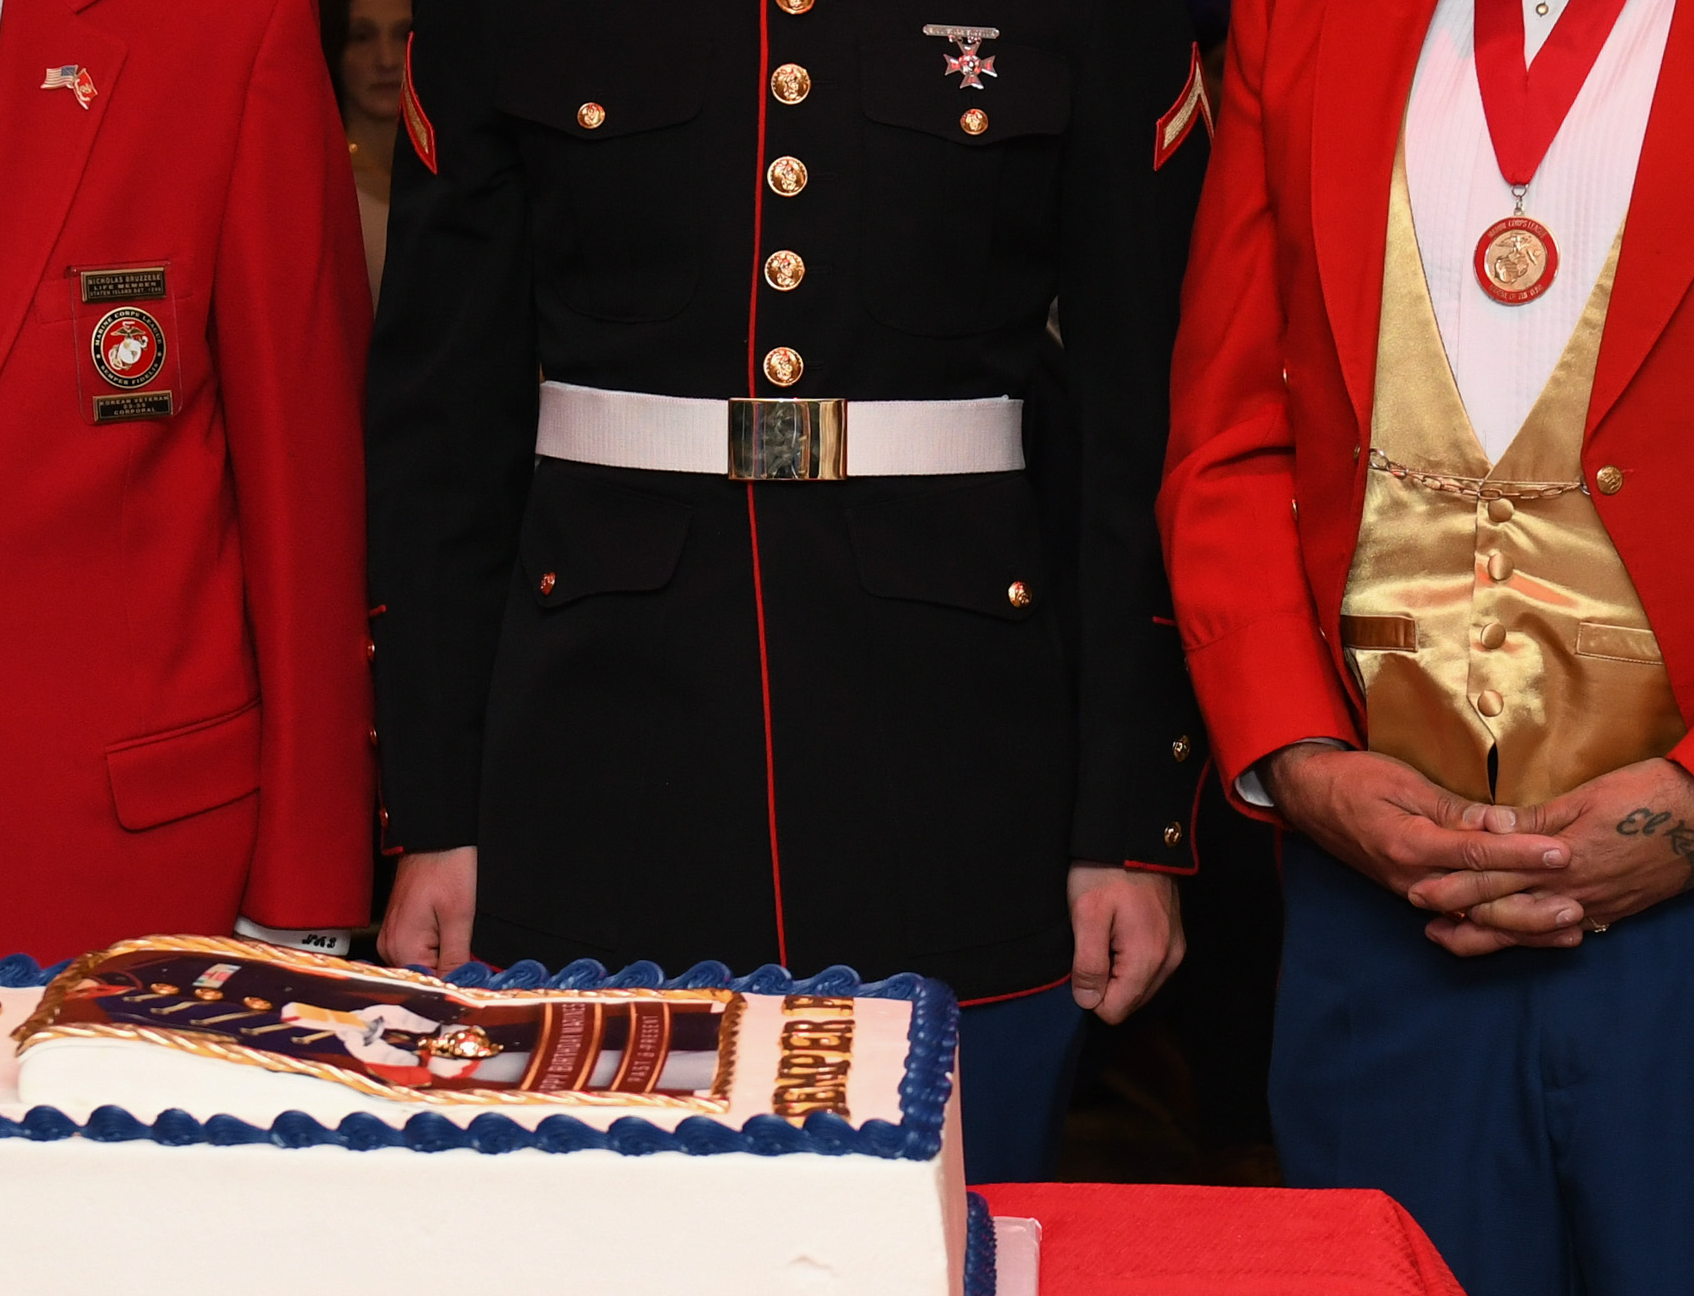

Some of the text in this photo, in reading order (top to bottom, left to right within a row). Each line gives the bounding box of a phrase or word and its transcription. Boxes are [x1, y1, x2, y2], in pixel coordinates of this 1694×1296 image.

[93, 281, 157, 291] LIFE MEMBER
[95, 310, 163, 346] MARINE CORPS LEAGUE
[100, 363, 159, 386] SEMPER FIDELIS
[99, 395, 168, 406] KOREAN VETERAN
[113, 407, 156, 415] CORPORAL
[561, 1003, 586, 1034] MARINES
[638, 1015, 659, 1051] PRESENT
[546, 1034, 583, 1073] BIRTHDAY
[627, 1060, 652, 1083] PAST
[772, 1019, 856, 1119] SEMPER
